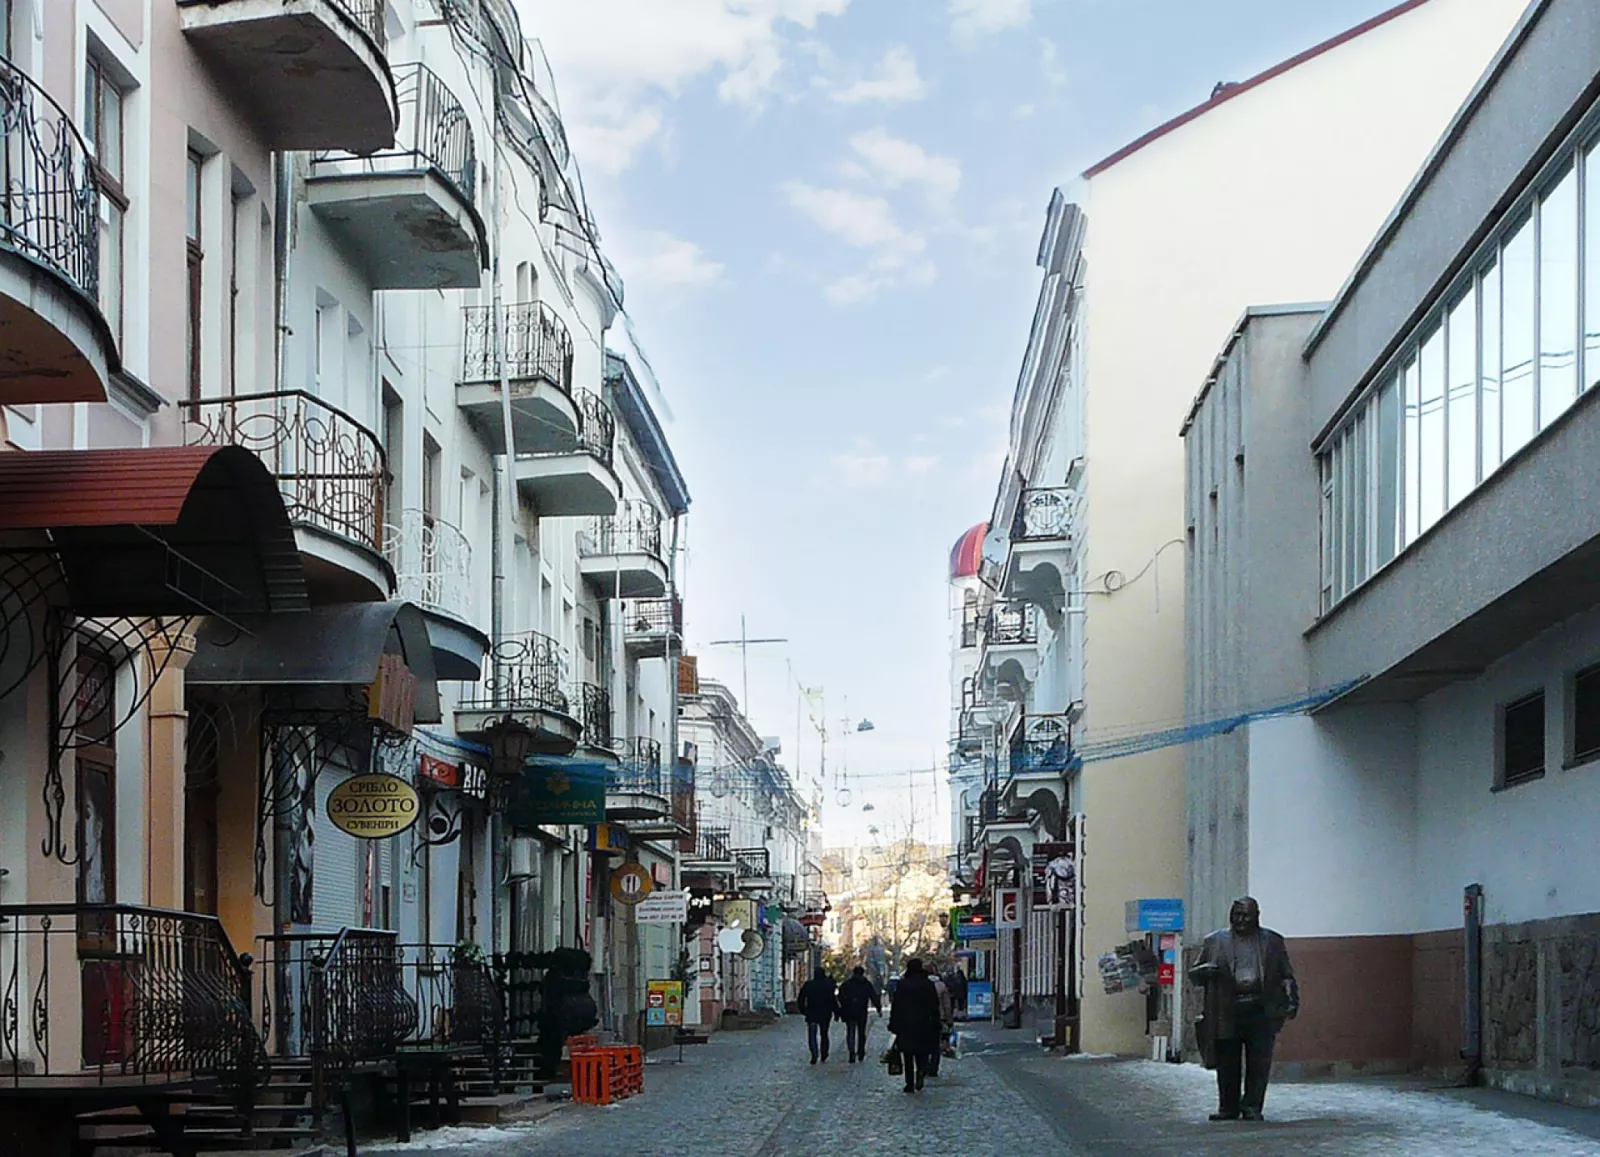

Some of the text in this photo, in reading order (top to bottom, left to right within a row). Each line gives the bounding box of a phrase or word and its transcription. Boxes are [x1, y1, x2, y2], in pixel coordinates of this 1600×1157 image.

[349, 781, 399, 793] СРІБЛО
[332, 798, 415, 813] ЗОЛОТО
[346, 820, 399, 829] СУВЕНІРИ
